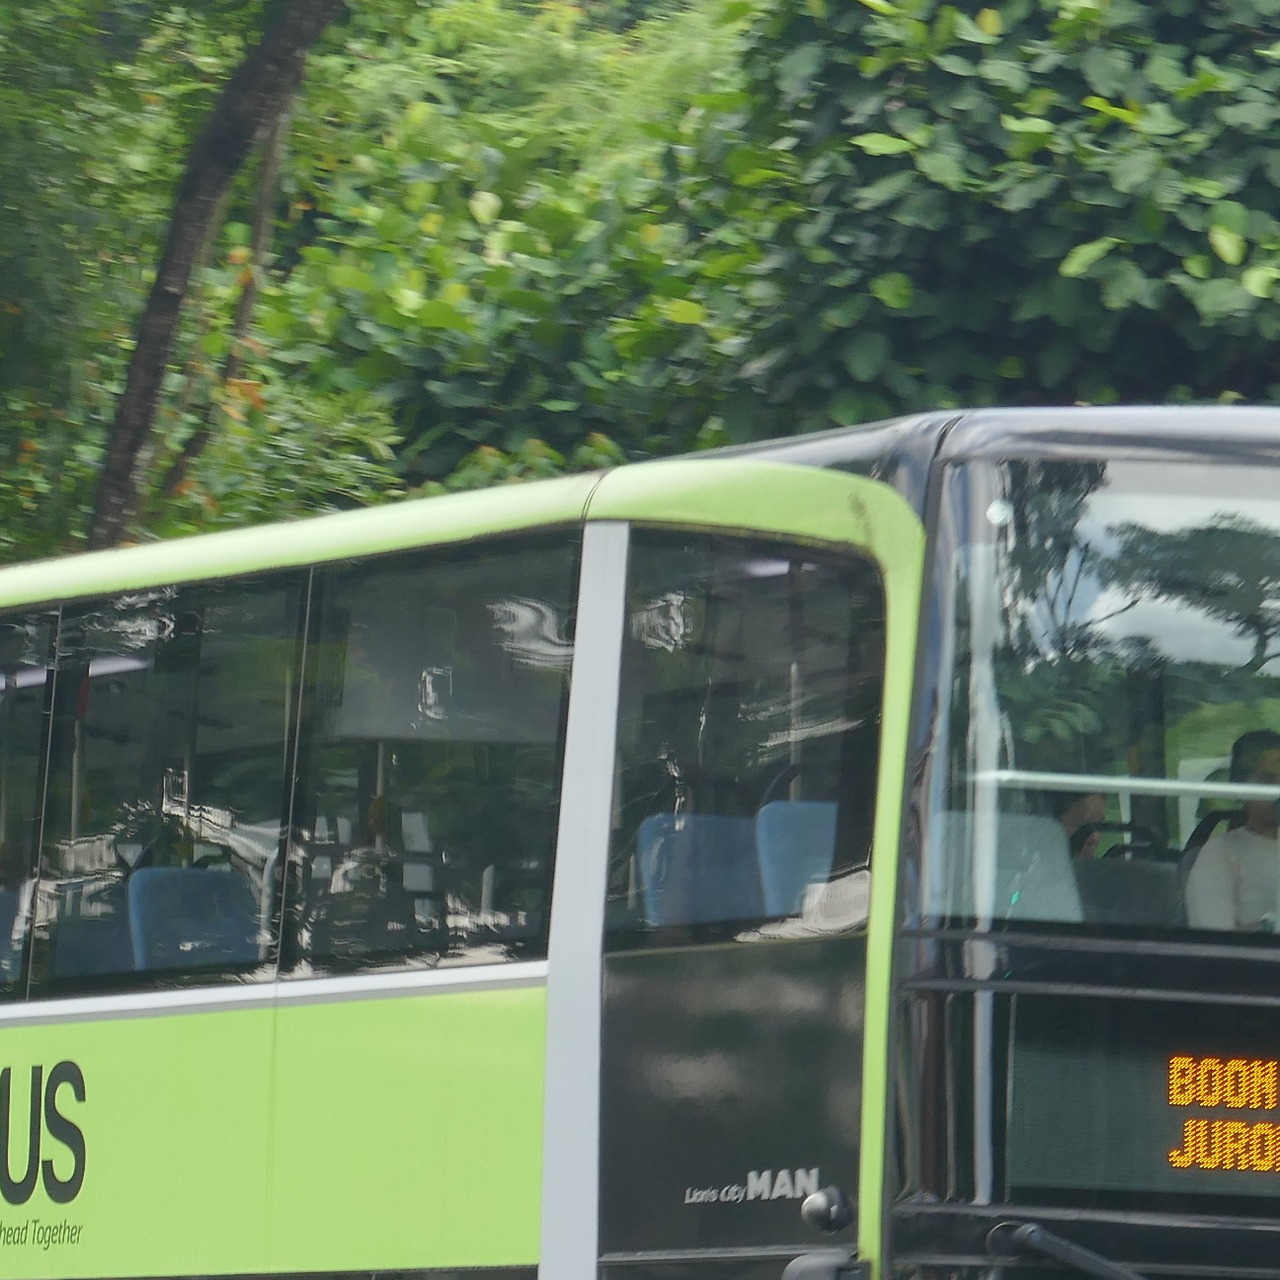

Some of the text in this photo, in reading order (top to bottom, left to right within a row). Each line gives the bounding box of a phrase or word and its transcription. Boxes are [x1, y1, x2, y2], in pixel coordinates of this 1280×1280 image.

[1169, 1056, 1277, 1108] BOON
[747, 1167, 820, 1200] MAN
[32, 1219, 83, 1251] Together
